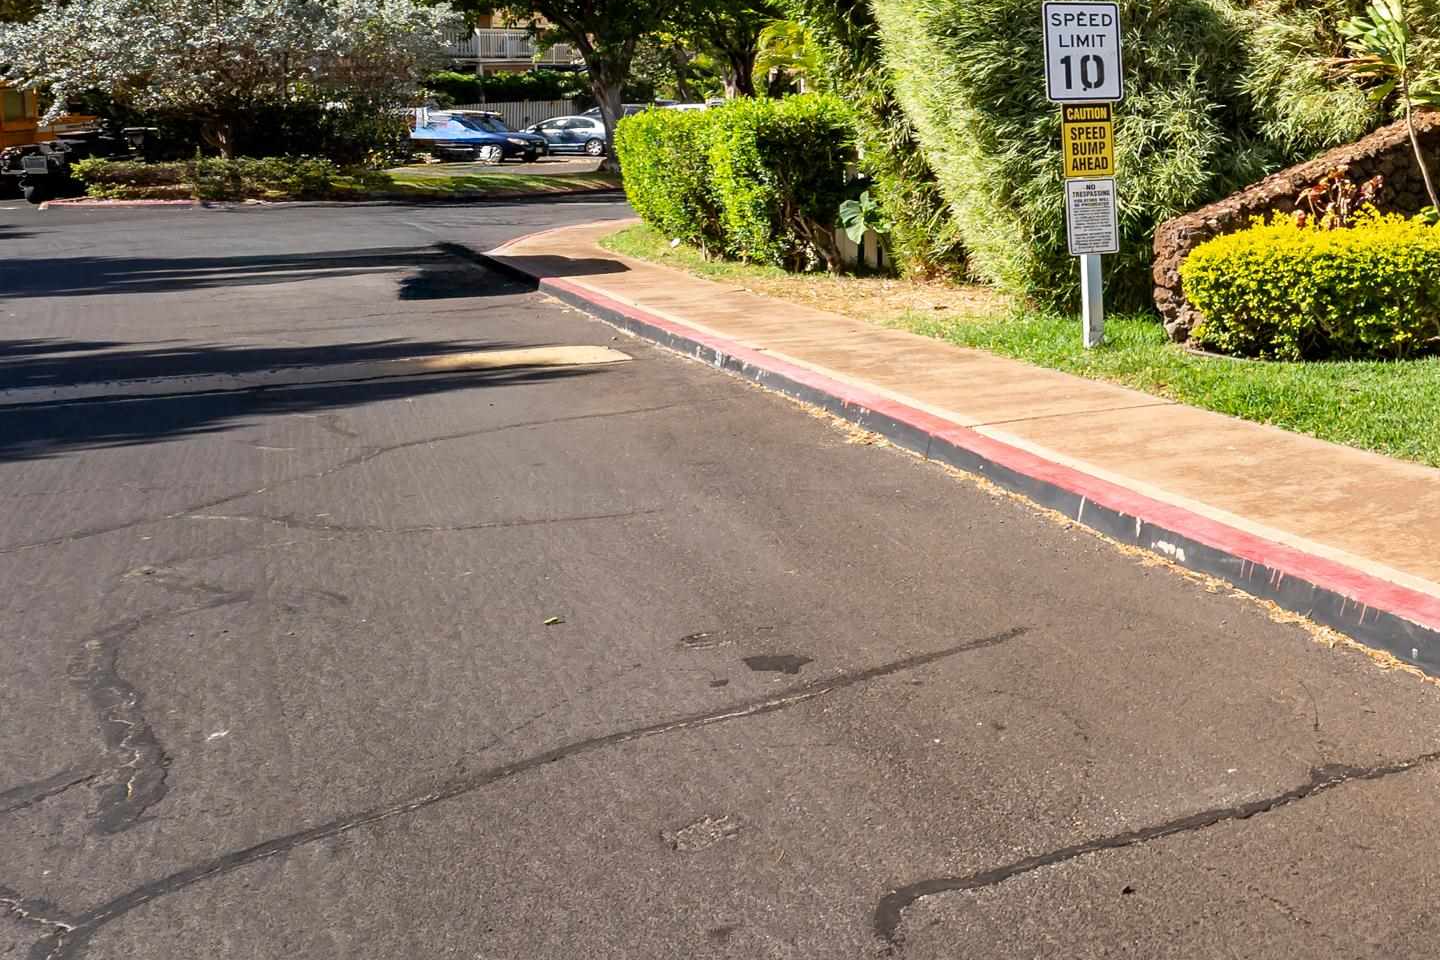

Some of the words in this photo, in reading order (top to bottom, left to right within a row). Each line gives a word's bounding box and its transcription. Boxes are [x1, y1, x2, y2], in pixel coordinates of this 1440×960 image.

[1051, 12, 1112, 27] SPEED
[1059, 34, 1106, 48] LIMIT
[1060, 54, 1105, 90] 10
[1066, 107, 1107, 121] CAUTION
[1070, 126, 1106, 140] SPEED
[1072, 142, 1106, 156] BUMP
[1072, 157, 1108, 171] AHEAD
[1072, 190, 1110, 198] TRESPASSING
